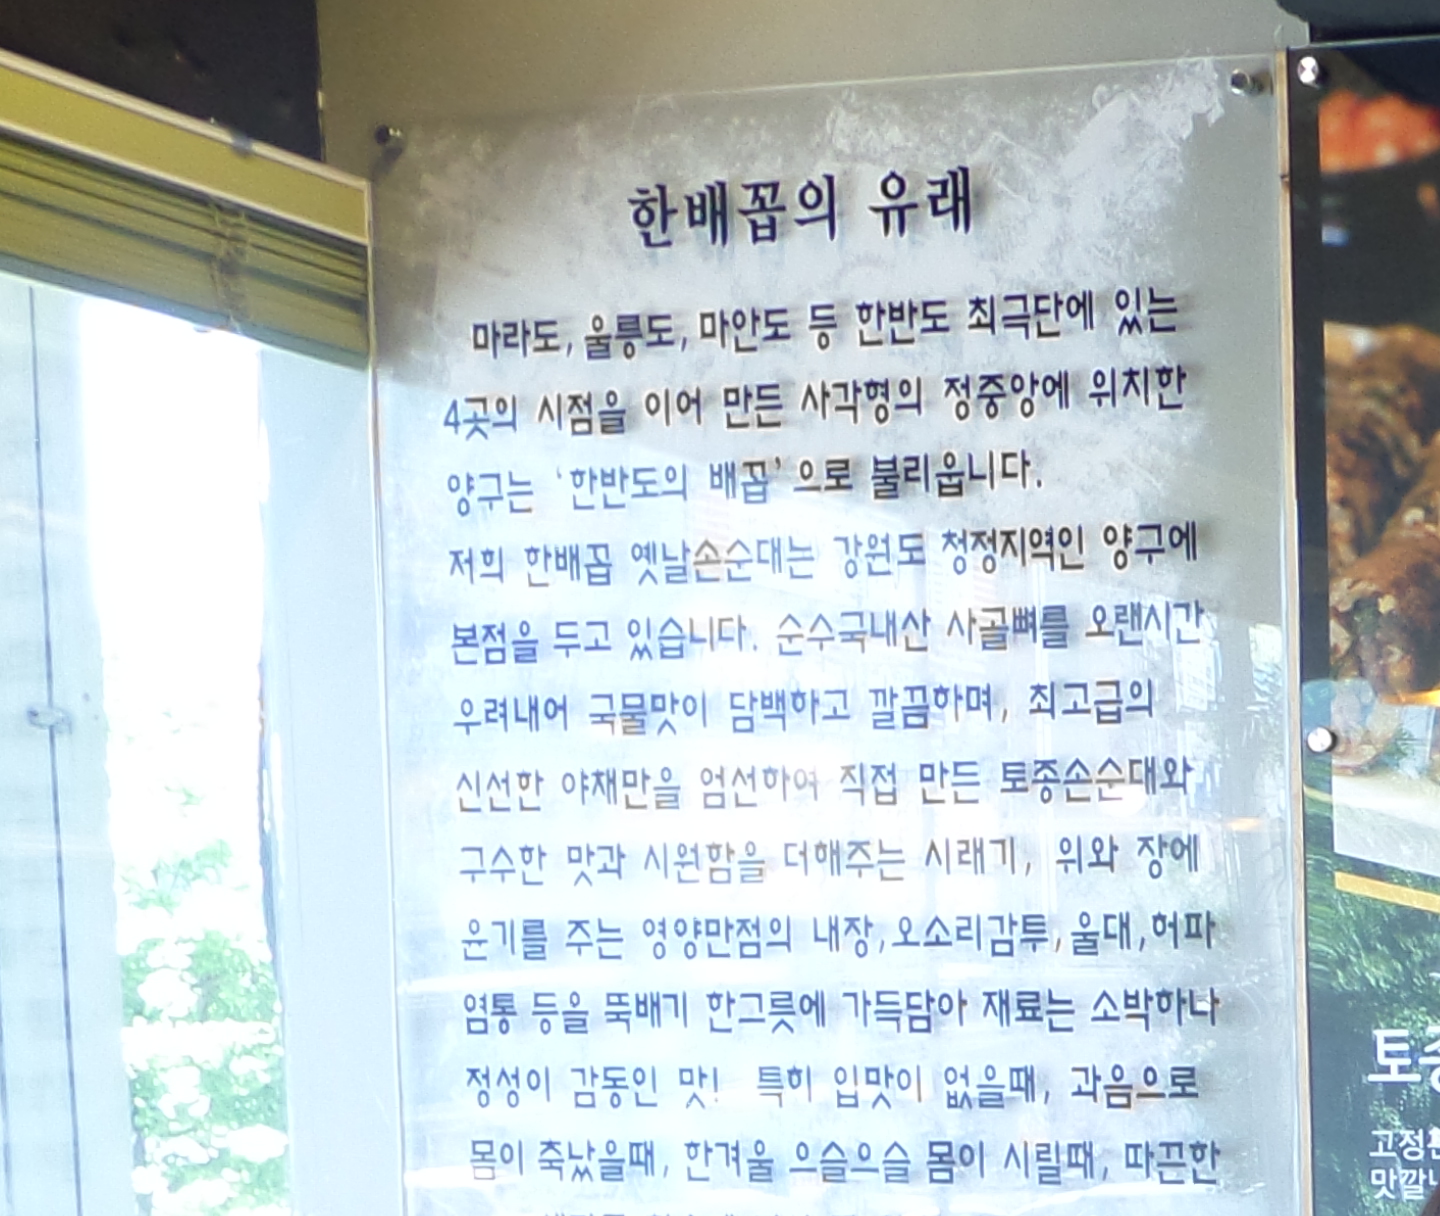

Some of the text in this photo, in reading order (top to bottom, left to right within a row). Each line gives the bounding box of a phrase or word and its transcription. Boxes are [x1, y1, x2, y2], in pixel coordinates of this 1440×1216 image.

[628, 165, 973, 248] 한배꼽의 유래
[473, 286, 1178, 360] 마라도, 울릉도, 마안도 등 한반도 최극단에 있는
[443, 364, 1187, 440] 4곳의 시점을 이어 만든 사각형의 정중앙에 위치한
[447, 471, 534, 517] 양구는
[793, 458, 852, 492] 으로
[871, 449, 1042, 499] 불리웁니다.
[449, 521, 1197, 587] 저희 한배꼽 옛날손순대는 강원도 청정지역인 양구에
[451, 599, 1205, 665] 본점을 두고 있습니다. 순수국내산 사골뼈를 오랜시간
[453, 677, 1153, 735] 우려내어 국물맛이 담백하고 깔끔하며, 최고급의
[457, 755, 1194, 813] 신선한 야채만을 엄선하여 직접 만든 토종손순대와
[460, 833, 1199, 886] 구수한 맛과 시원함을 더해주는 시래기, 위와 장에
[461, 919, 547, 961] 윤기를
[565, 918, 624, 960] 주는
[642, 916, 791, 960] 영양만점의
[464, 987, 1220, 1035] 염통 등을 뚝배기 한그릇에 가득담아 재료는 소박하나
[466, 1066, 550, 1108] 정성이
[571, 1066, 658, 1109] 감동인
[757, 1065, 811, 1108] 특히
[834, 1064, 921, 1109] 입맛이
[944, 1064, 1050, 1111] 없을때,
[1071, 1064, 1202, 1109] 과음으로
[470, 1139, 1222, 1188] 몸이 축났을때, 한겨울 으슬으슬 몸이 시릴때, 따끈한
